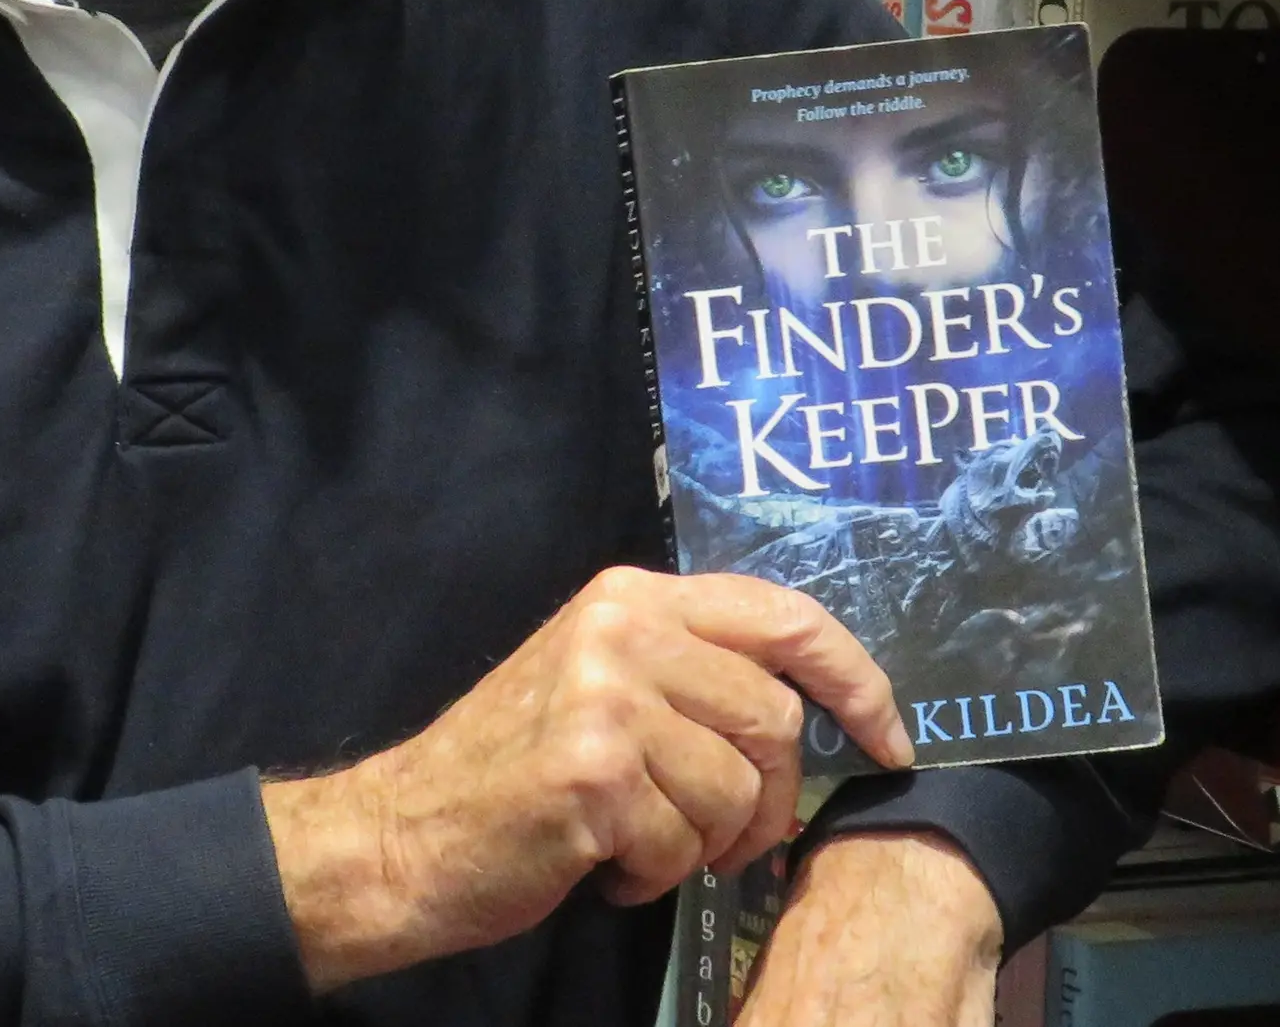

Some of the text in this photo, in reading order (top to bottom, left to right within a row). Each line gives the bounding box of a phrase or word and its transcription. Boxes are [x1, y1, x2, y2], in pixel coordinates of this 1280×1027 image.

[751, 67, 970, 103] Prophecy demands a journey.
[797, 96, 926, 122] Follow the riddle.
[807, 215, 947, 278] THE
[683, 275, 1083, 389] FINDER'S
[726, 380, 1086, 498] KEEPER
[911, 680, 1136, 745] KILDEA
